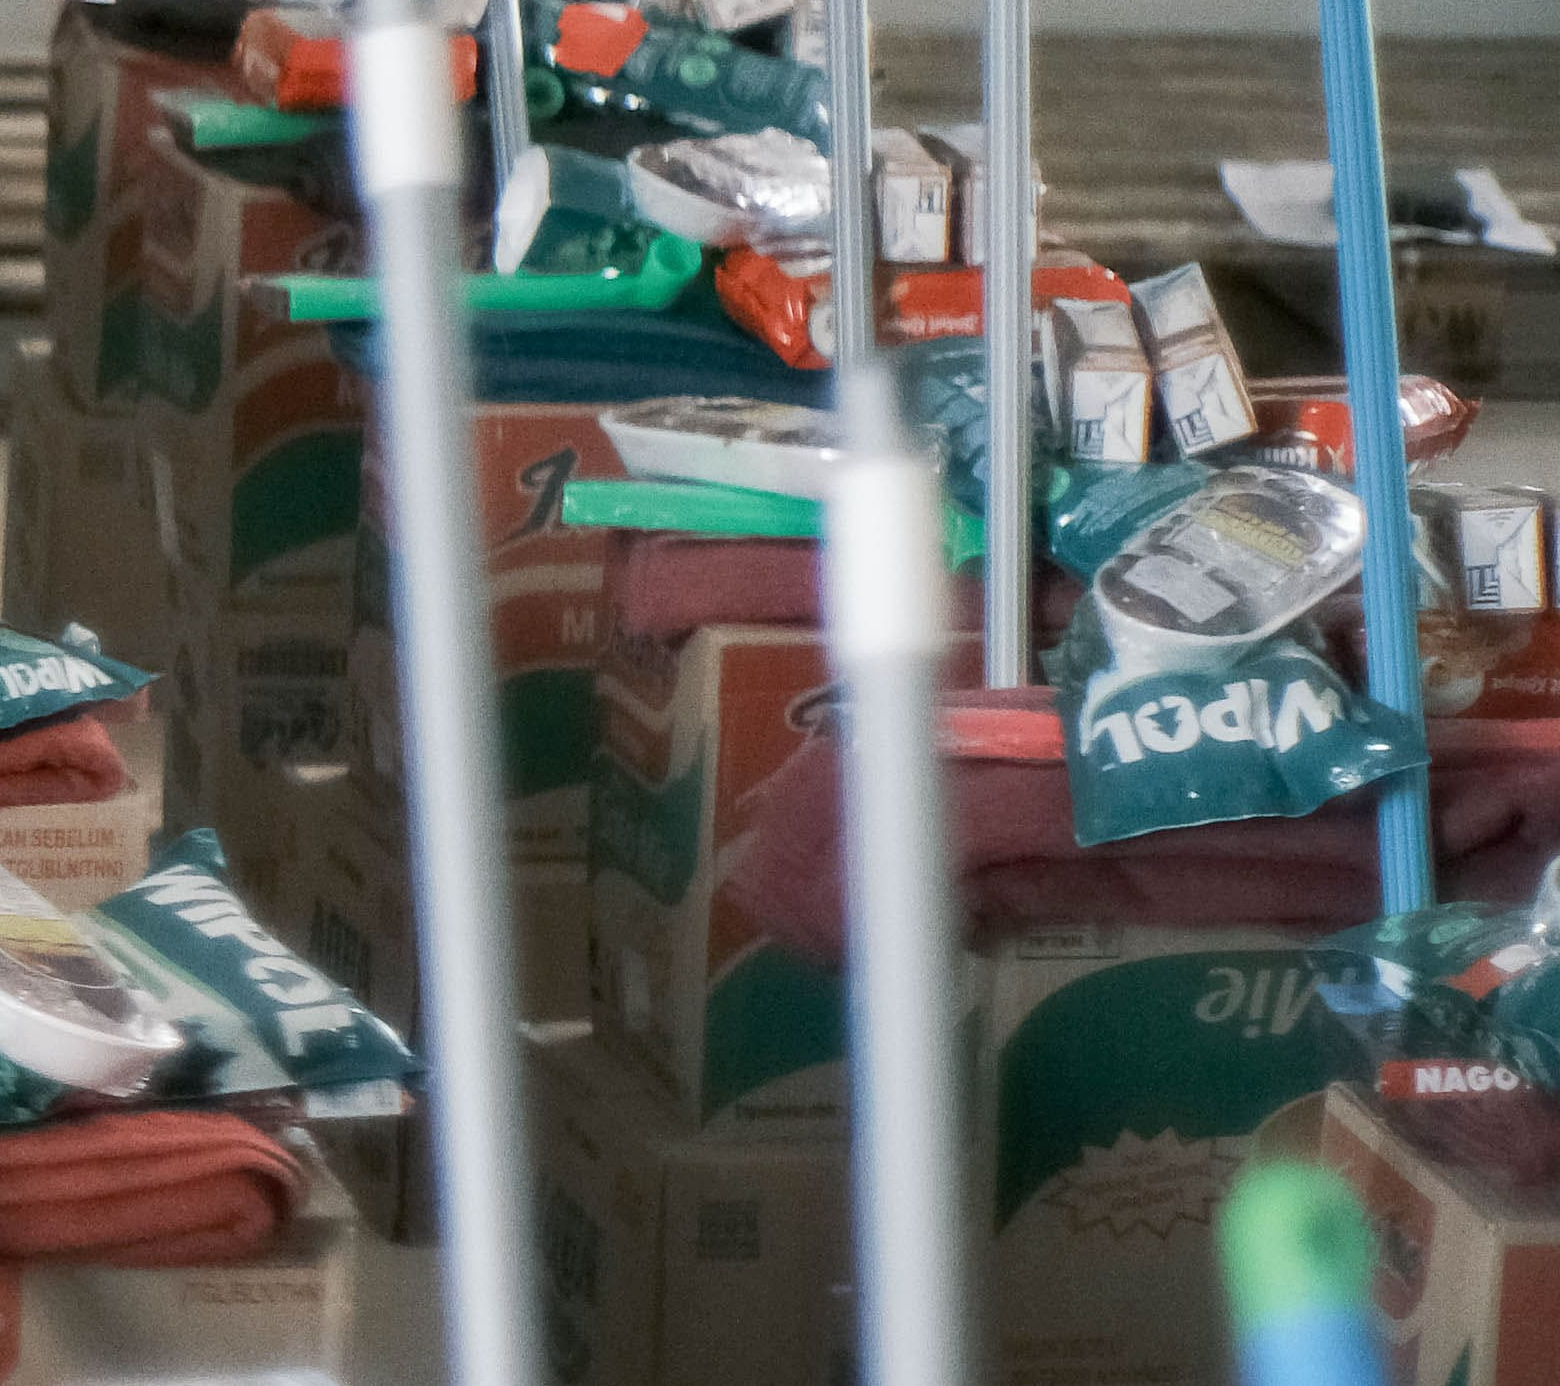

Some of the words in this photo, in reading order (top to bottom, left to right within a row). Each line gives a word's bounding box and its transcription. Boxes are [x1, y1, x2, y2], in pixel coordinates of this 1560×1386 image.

[1100, 677, 1345, 770] WIPOL
[128, 864, 357, 1057] WIPOL
[1414, 1063, 1520, 1094] NAGO
